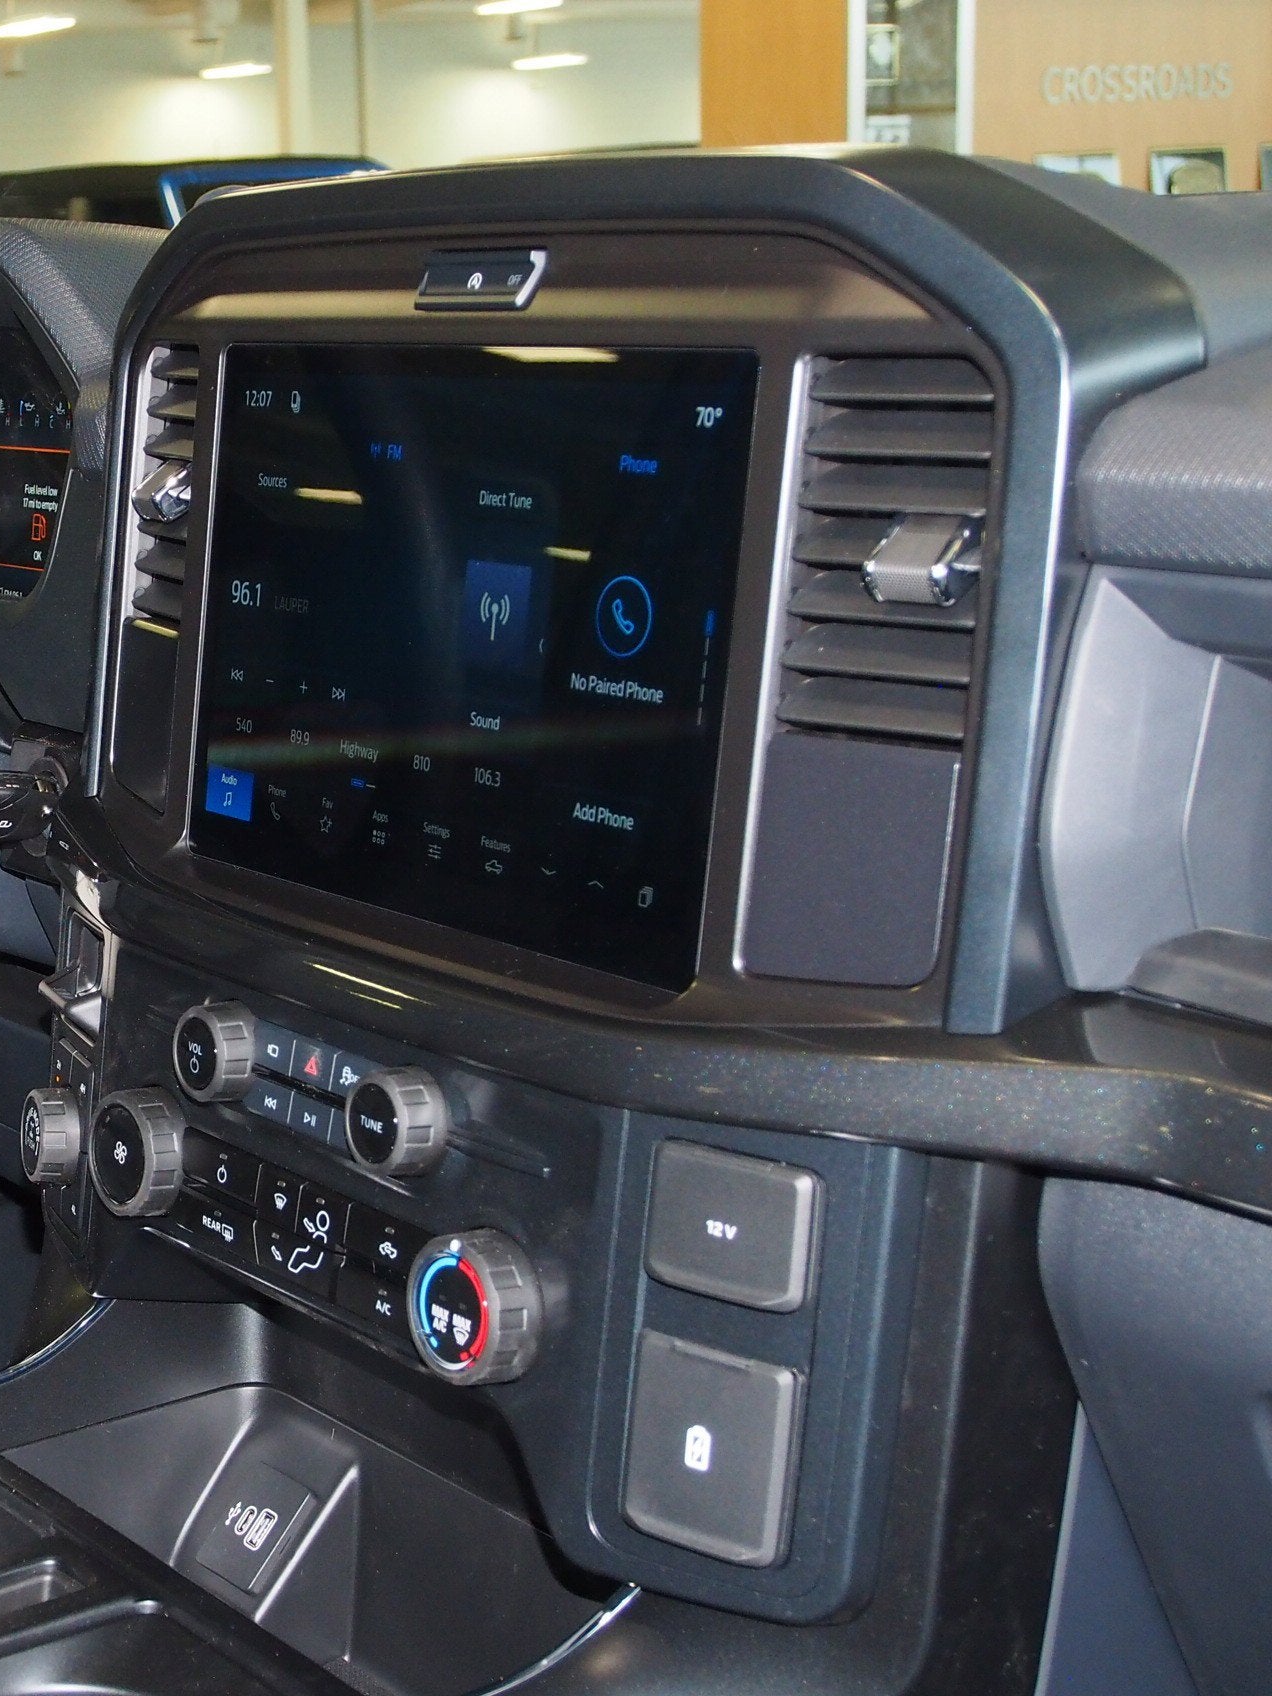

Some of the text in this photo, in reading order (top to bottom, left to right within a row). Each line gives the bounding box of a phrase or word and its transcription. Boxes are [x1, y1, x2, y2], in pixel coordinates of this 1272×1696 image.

[1042, 62, 1234, 105] CROSSROADS
[507, 274, 524, 286] OFF
[244, 390, 273, 408] 12:07
[387, 444, 403, 461] FM
[619, 454, 658, 475] Phone
[24, 483, 35, 495] Fuel
[257, 472, 288, 489] Sources
[479, 490, 533, 509] Direct Tune
[33, 550, 43, 561] OK
[231, 580, 262, 608] 96.1
[570, 672, 664, 703] No Paired Phone
[235, 717, 253, 733] 540
[470, 711, 501, 731] Sound
[290, 729, 310, 746] 89.9
[339, 739, 379, 763] Highway
[413, 754, 431, 772] 810
[221, 773, 238, 786] Audio
[474, 767, 501, 787] 106.3
[267, 784, 287, 798] Phone
[322, 797, 334, 810] Fav
[372, 810, 389, 824] Apps
[573, 802, 634, 831] Add Phone
[422, 821, 451, 839] Settings
[480, 835, 512, 853] Features
[188, 1040, 203, 1056] VOL
[359, 1113, 384, 1134] TUNE
[202, 1214, 223, 1233] REAR
[374, 1299, 393, 1317] A/C
[431, 1303, 450, 1323] MAX
[452, 1313, 472, 1333] MAX
